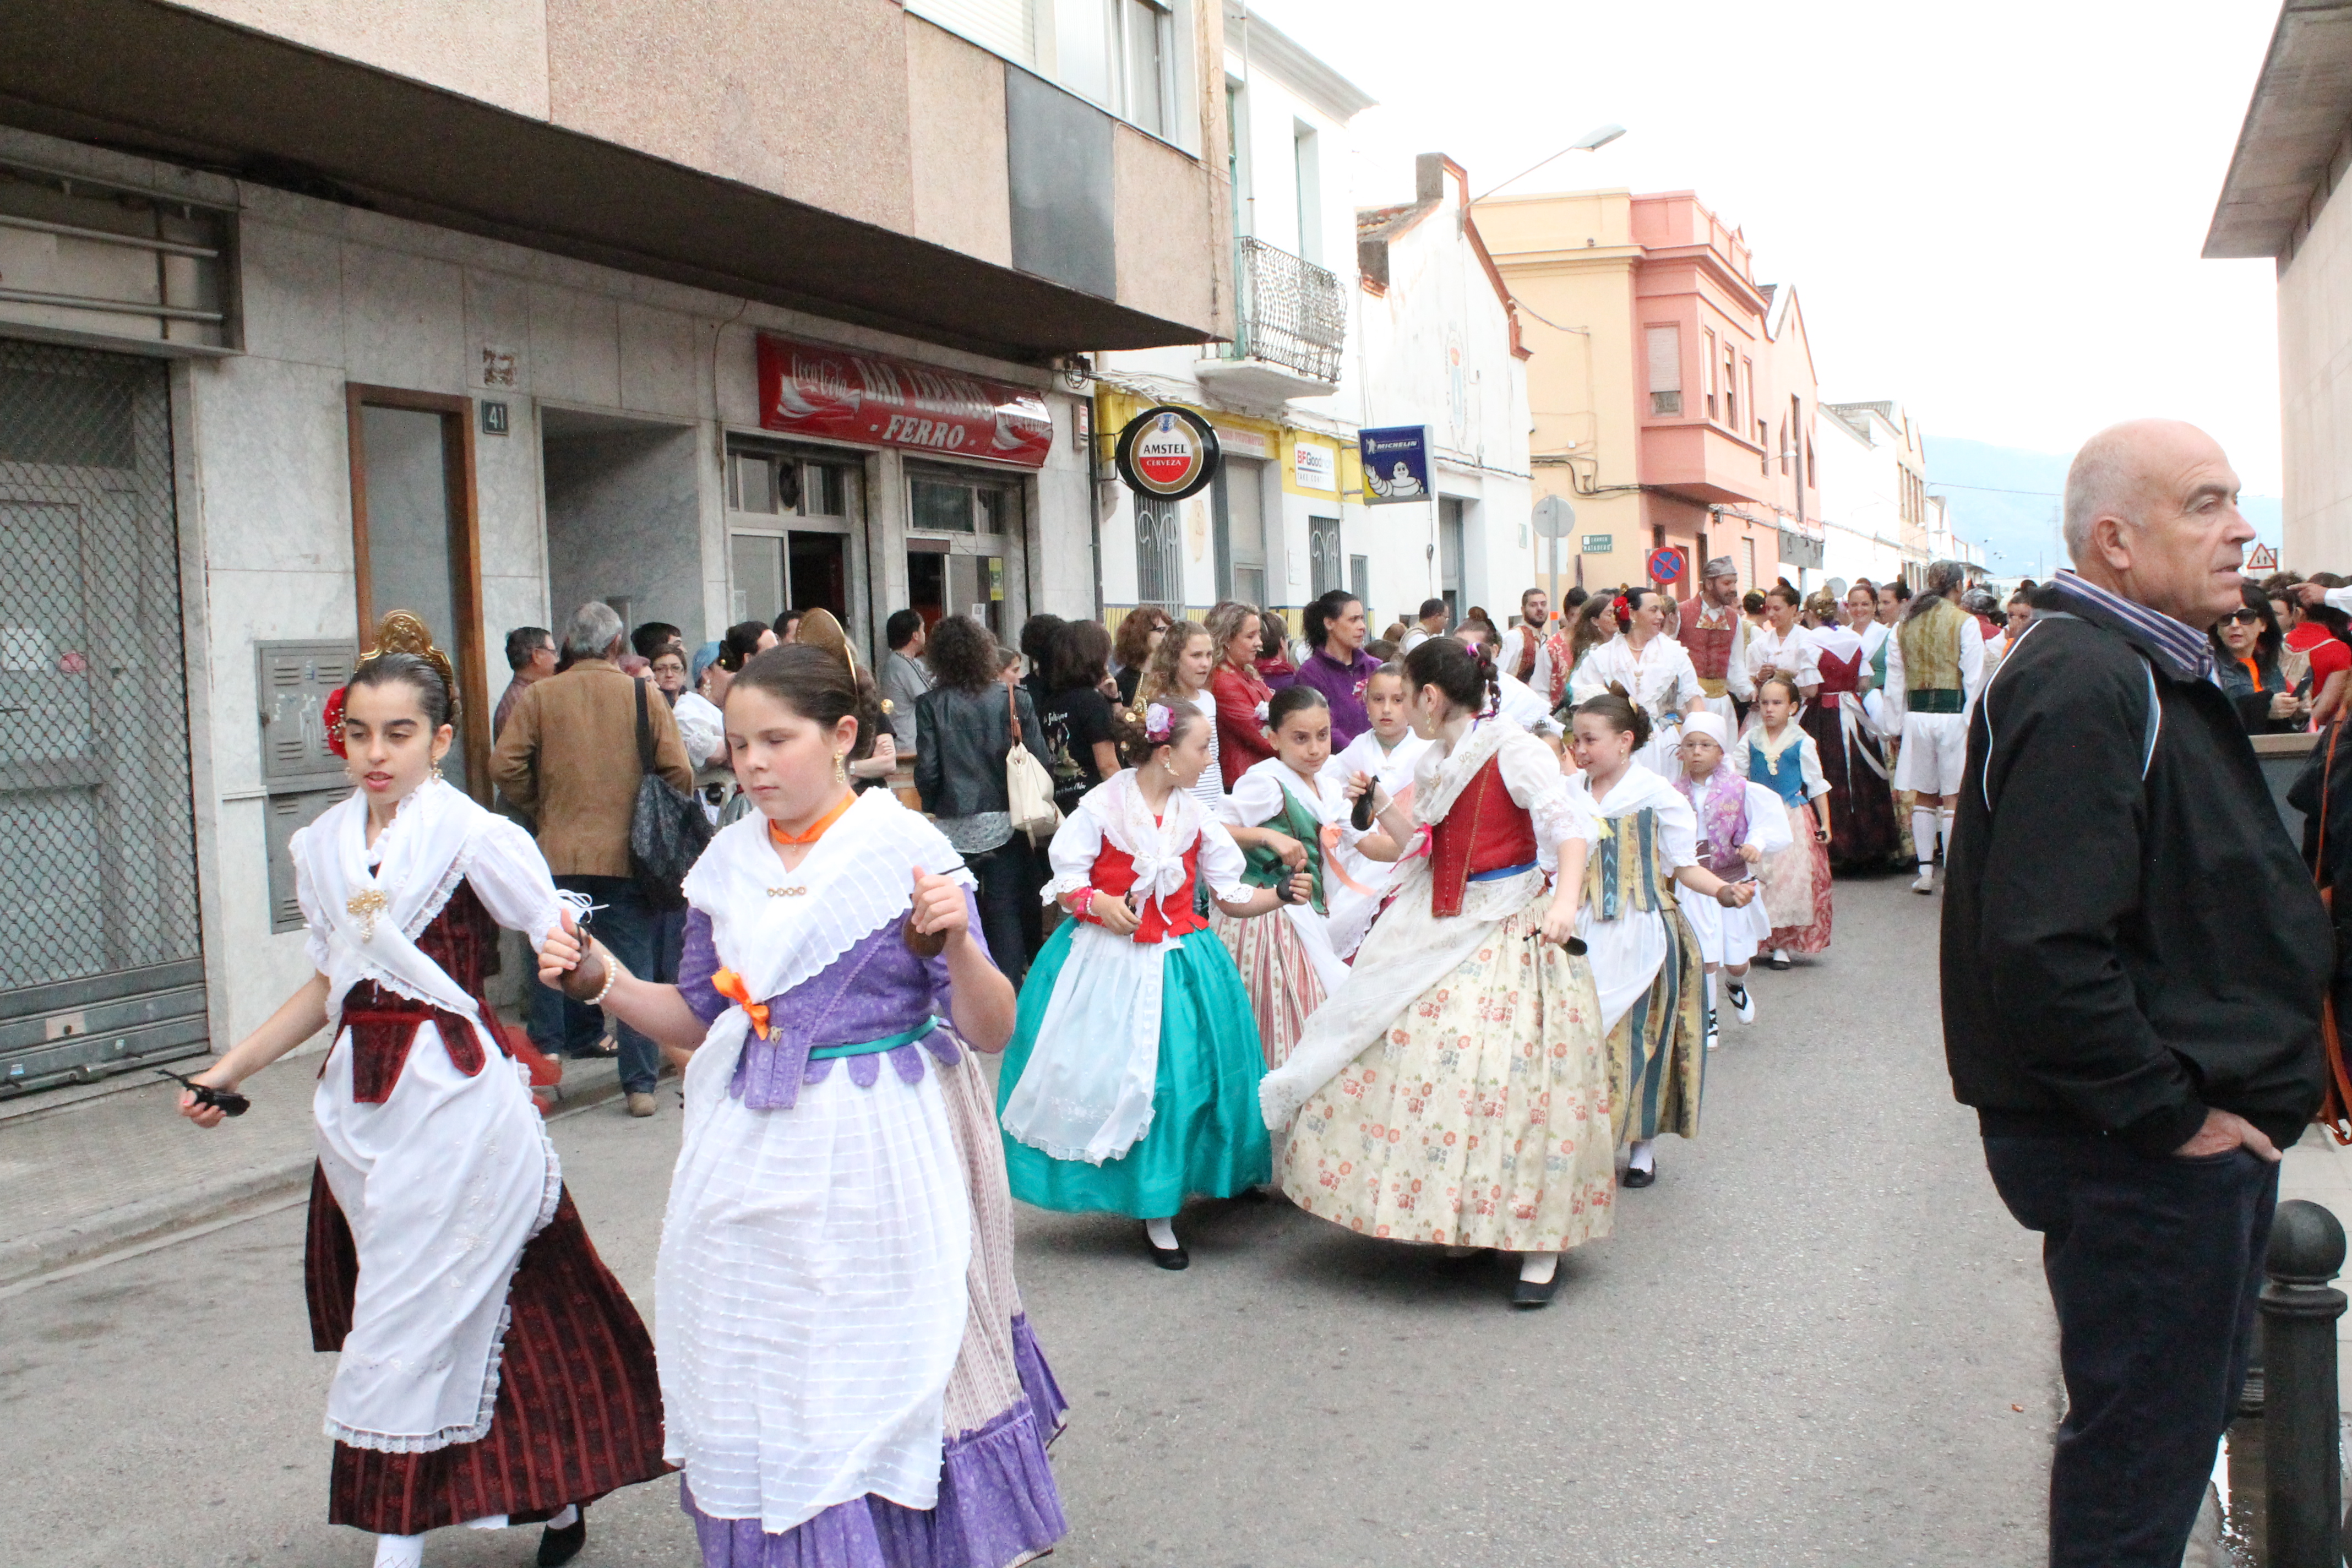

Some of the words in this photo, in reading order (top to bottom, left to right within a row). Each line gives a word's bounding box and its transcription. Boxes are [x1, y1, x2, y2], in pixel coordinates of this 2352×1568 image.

[852, 357, 905, 406] BAR
[489, 406, 504, 428] 41
[882, 414, 965, 449] FERRO
[1144, 444, 1187, 454] AMSTEL
[1377, 440, 1418, 449] MICHELIN
[1297, 472, 1309, 481] TAKE
